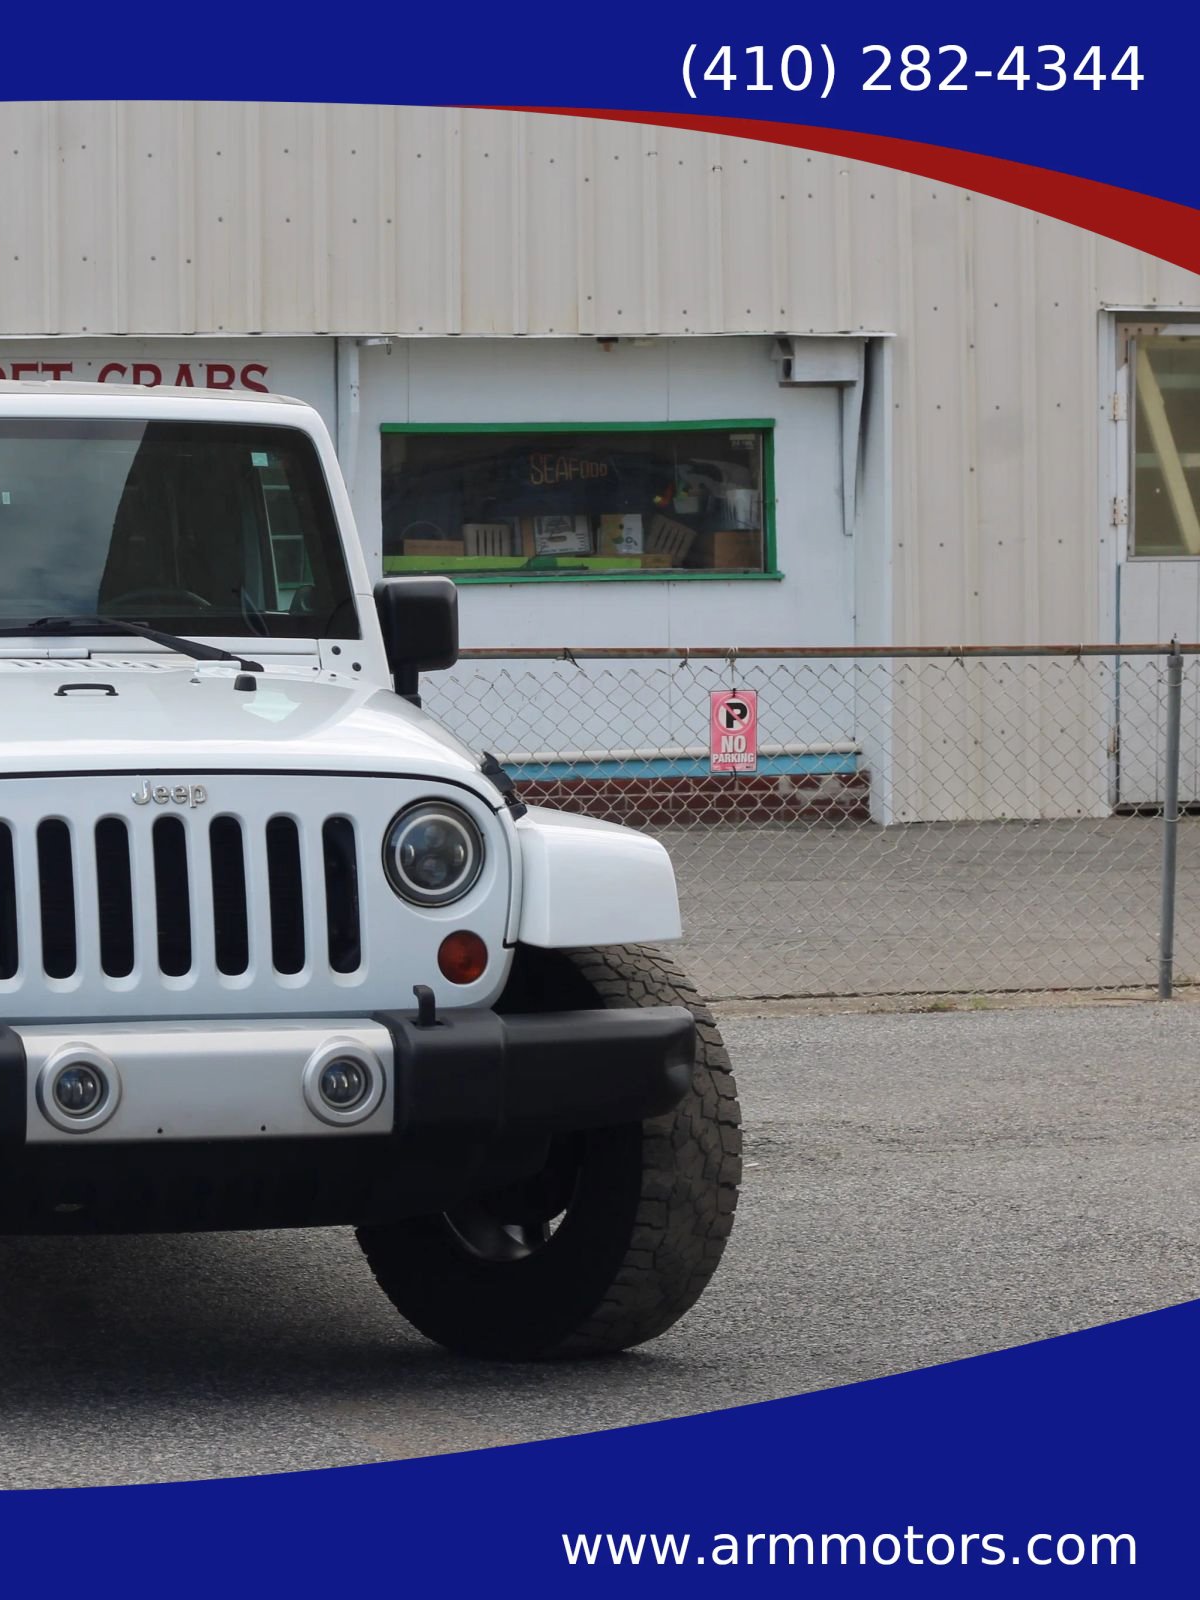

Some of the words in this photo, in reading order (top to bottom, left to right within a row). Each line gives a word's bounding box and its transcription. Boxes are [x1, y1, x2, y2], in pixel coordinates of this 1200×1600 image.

[529, 450, 608, 485] SEAFOOD
[721, 735, 746, 753] NO
[712, 753, 754, 763] PARKING
[131, 779, 208, 809] Jeep
